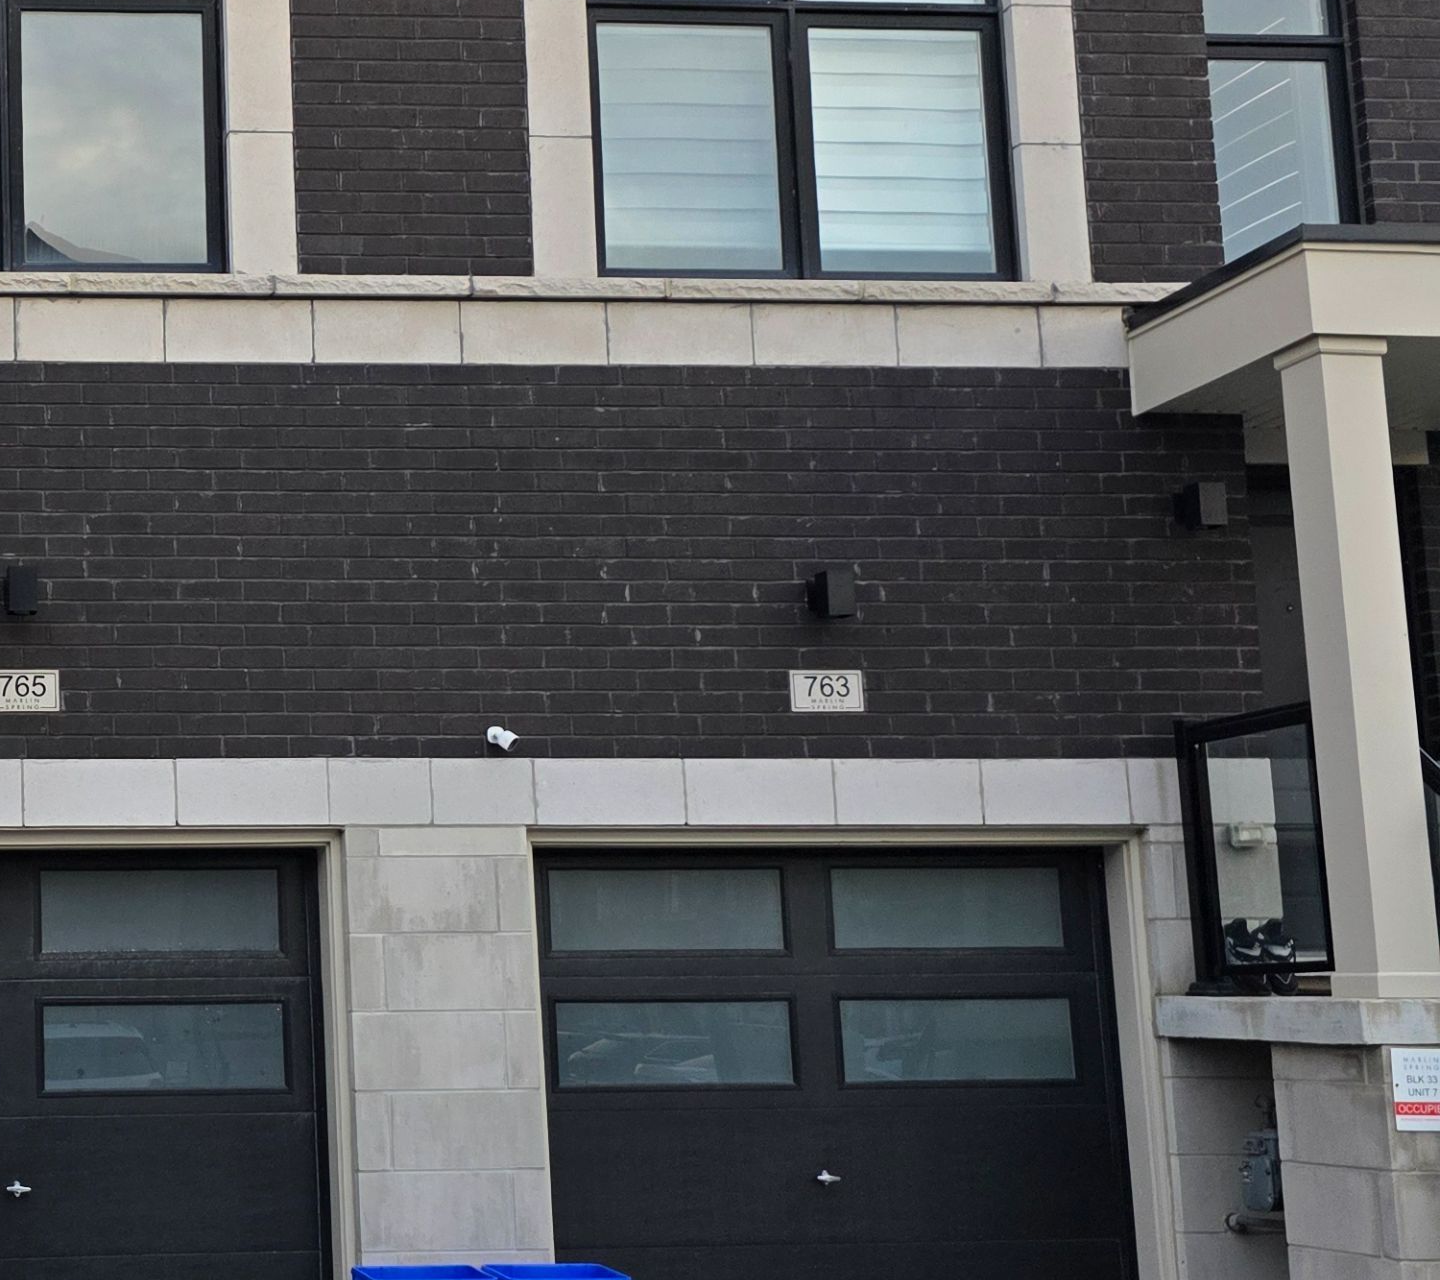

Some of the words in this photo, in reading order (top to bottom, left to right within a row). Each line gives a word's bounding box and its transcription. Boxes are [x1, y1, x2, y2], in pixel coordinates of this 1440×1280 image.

[803, 675, 850, 697] 763
[1406, 1075, 1425, 1084] BLK
[1428, 1075, 1438, 1084] 33
[1408, 1088, 1430, 1096] UNIT
[1432, 1088, 1438, 1096] 7
